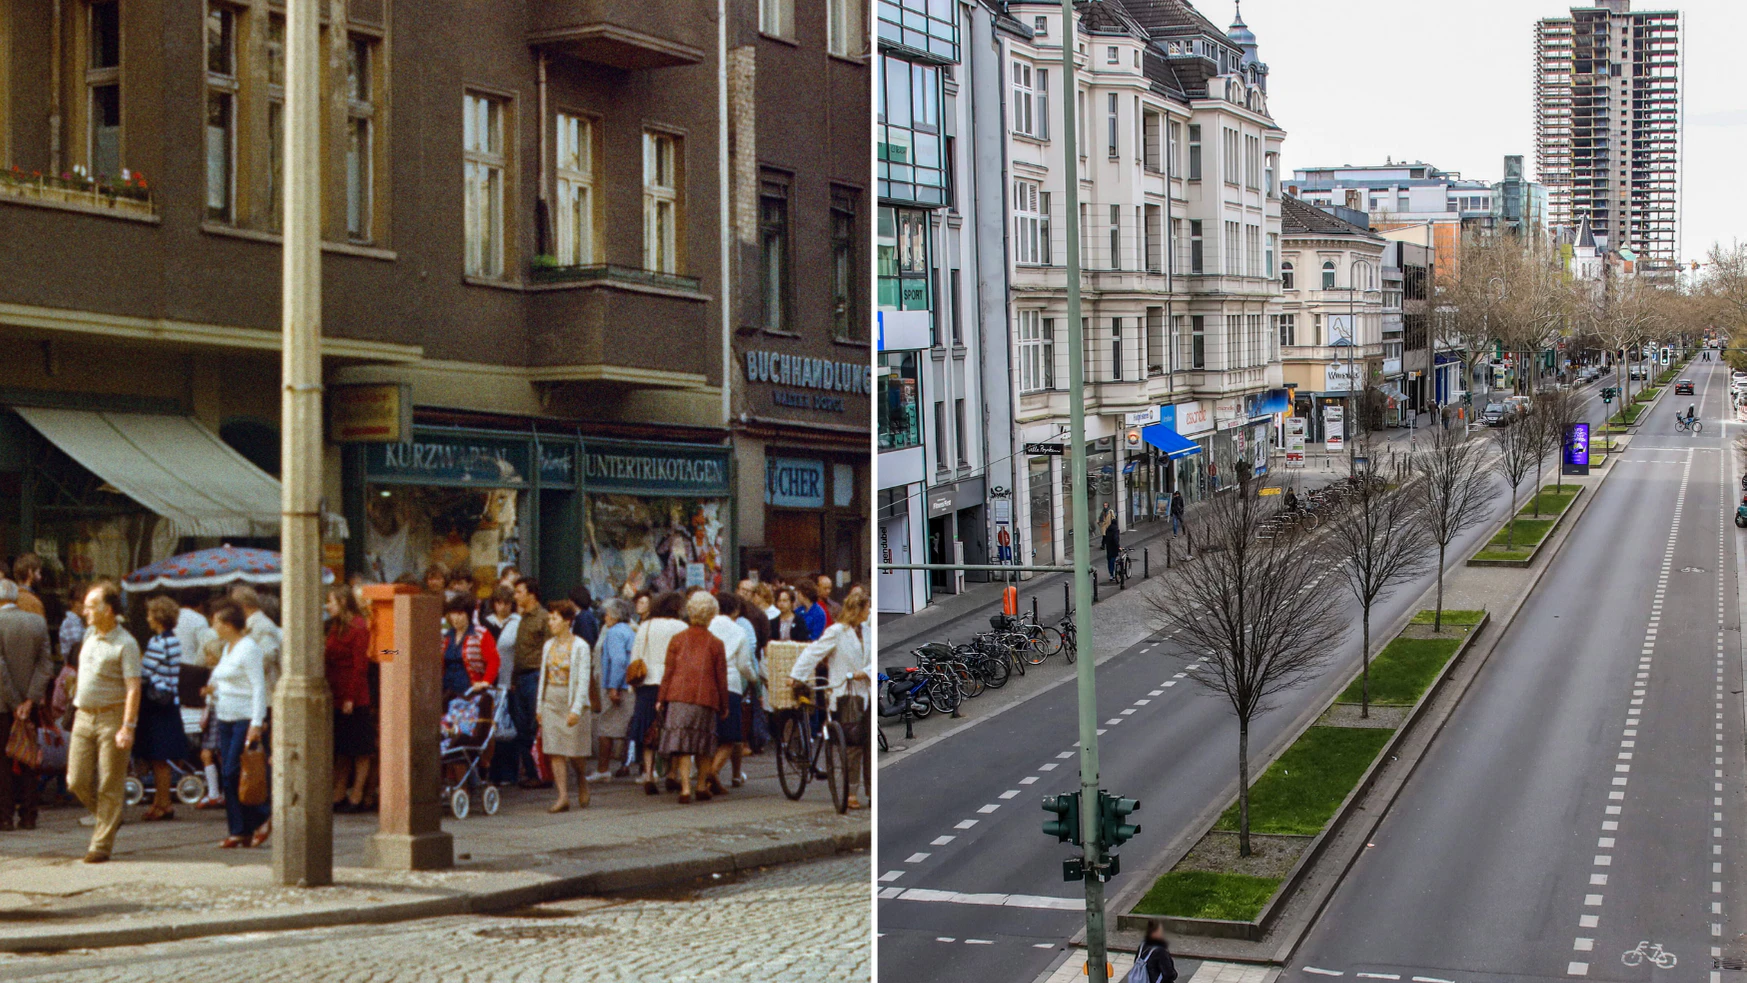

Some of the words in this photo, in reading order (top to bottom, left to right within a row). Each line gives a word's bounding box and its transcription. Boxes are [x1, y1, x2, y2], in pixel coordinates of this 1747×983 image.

[903, 289, 923, 301] SPORT
[746, 350, 871, 394] BUCHHANDLUNG
[585, 453, 723, 483] UNTERTRIKOTAGEN
[880, 526, 890, 575] Hgendubel
